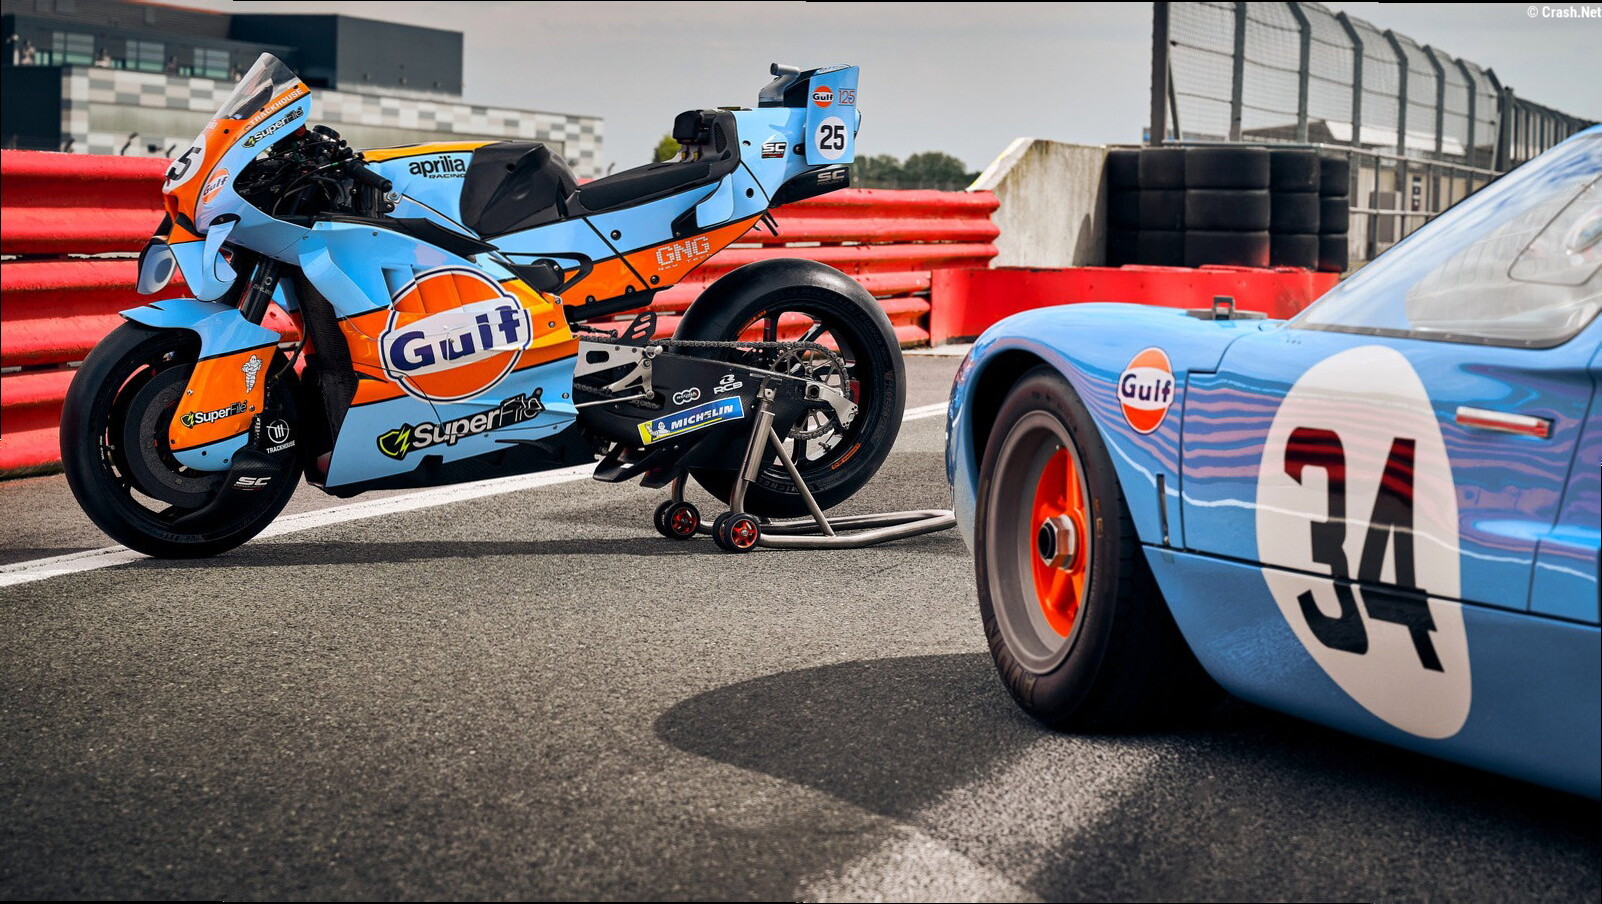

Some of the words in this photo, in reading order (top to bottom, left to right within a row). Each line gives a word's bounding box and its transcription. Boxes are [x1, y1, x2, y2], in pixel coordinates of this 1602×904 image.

[250, 88, 304, 126] TRACKHOUSE
[813, 92, 834, 101] Gulf
[838, 90, 856, 104] 125
[254, 107, 304, 141] SuperFile
[762, 143, 786, 152] SC
[820, 125, 845, 150] 25
[165, 146, 202, 187] 5
[409, 155, 466, 177] aprilia
[817, 169, 845, 182] SC
[204, 176, 228, 195] Gulf
[389, 305, 520, 371] Gulf
[713, 381, 743, 394] RCB
[1121, 373, 1172, 403] Gulf
[194, 400, 248, 424] SuperFile
[412, 394, 544, 448] SuperFile
[671, 404, 734, 430] MICHELIN
[266, 440, 296, 454] TRACKHOUSE
[1284, 426, 1445, 673] 34
